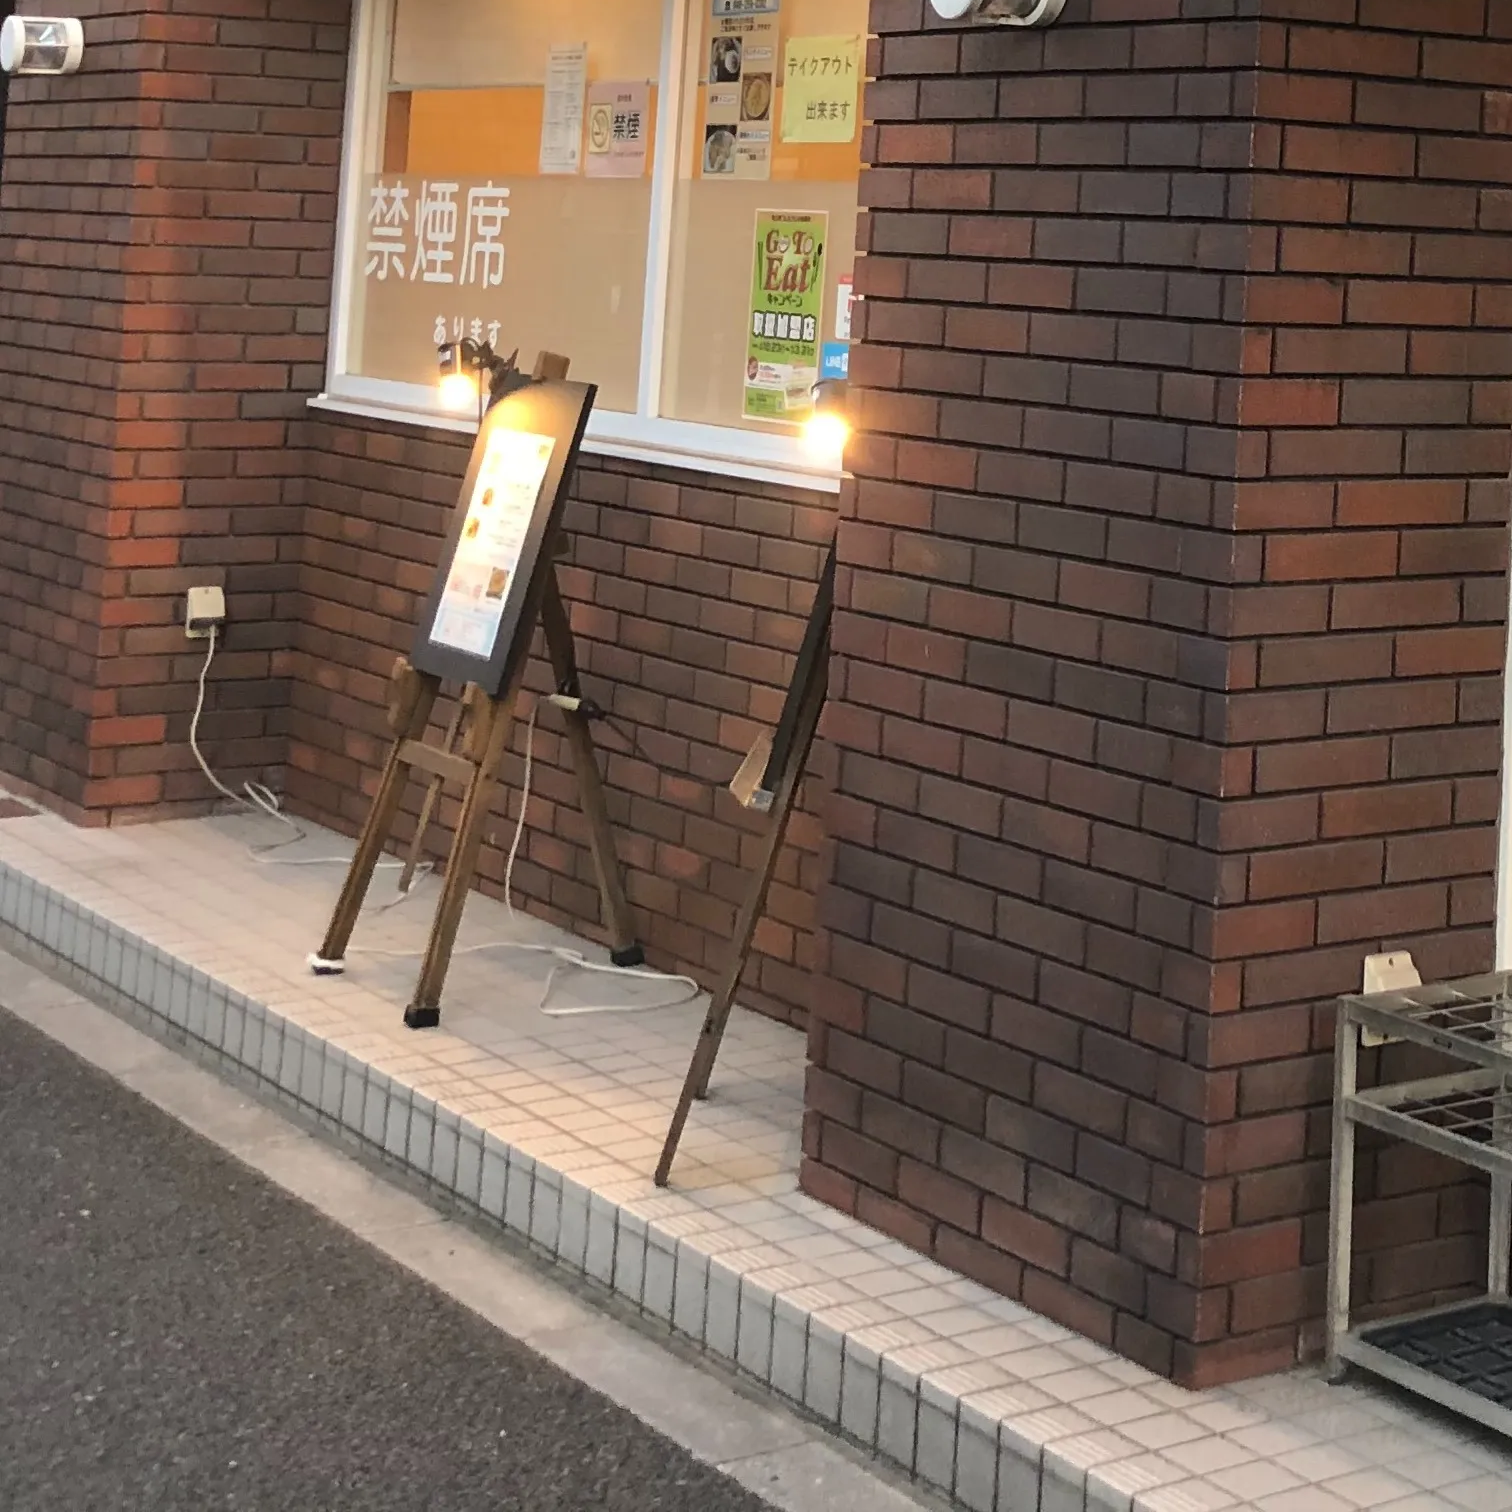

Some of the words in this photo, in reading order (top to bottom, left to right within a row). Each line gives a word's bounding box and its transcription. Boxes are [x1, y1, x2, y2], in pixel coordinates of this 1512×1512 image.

[788, 54, 853, 77] テイクアウト
[806, 100, 850, 122] 出来ます
[364, 180, 511, 289] 禁煙席
[434, 314, 502, 349] あります
